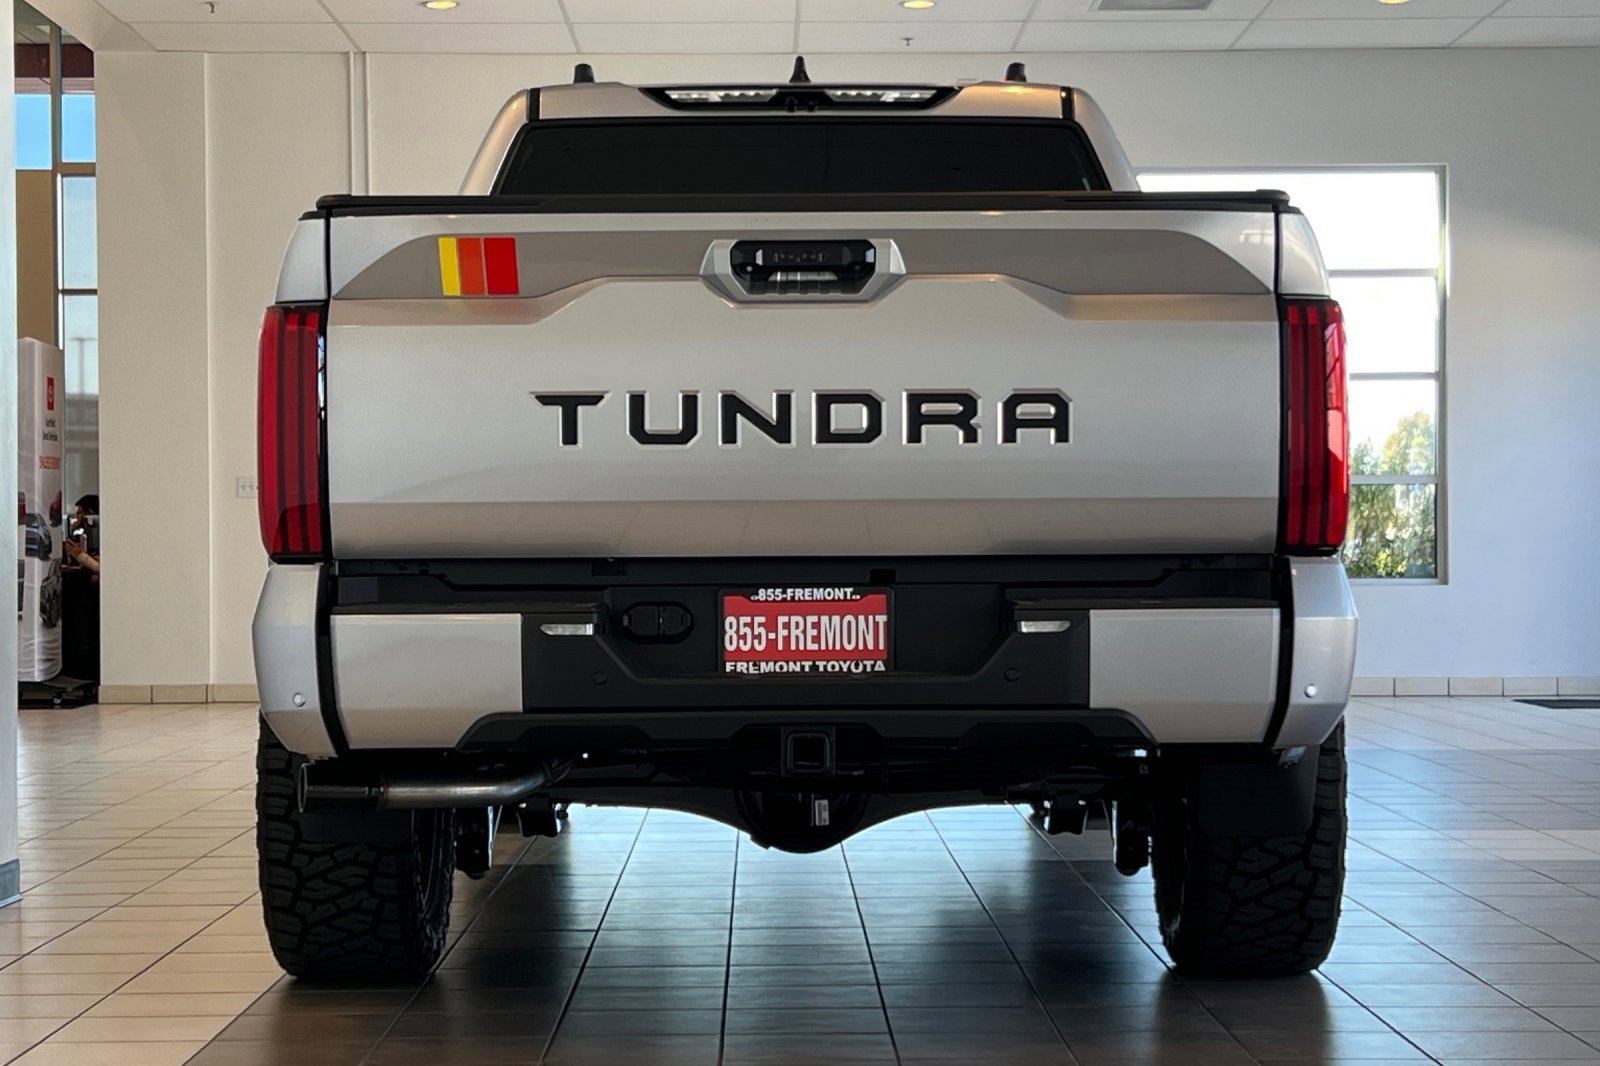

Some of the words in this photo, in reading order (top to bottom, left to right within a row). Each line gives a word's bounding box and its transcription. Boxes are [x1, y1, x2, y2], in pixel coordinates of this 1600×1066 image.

[531, 388, 1076, 447] TUNDRA
[757, 587, 854, 601] 855-FREMONT
[724, 614, 888, 652] 855-FREMONT
[725, 660, 813, 674] FREMONT
[815, 660, 886, 674] TOYOTA
